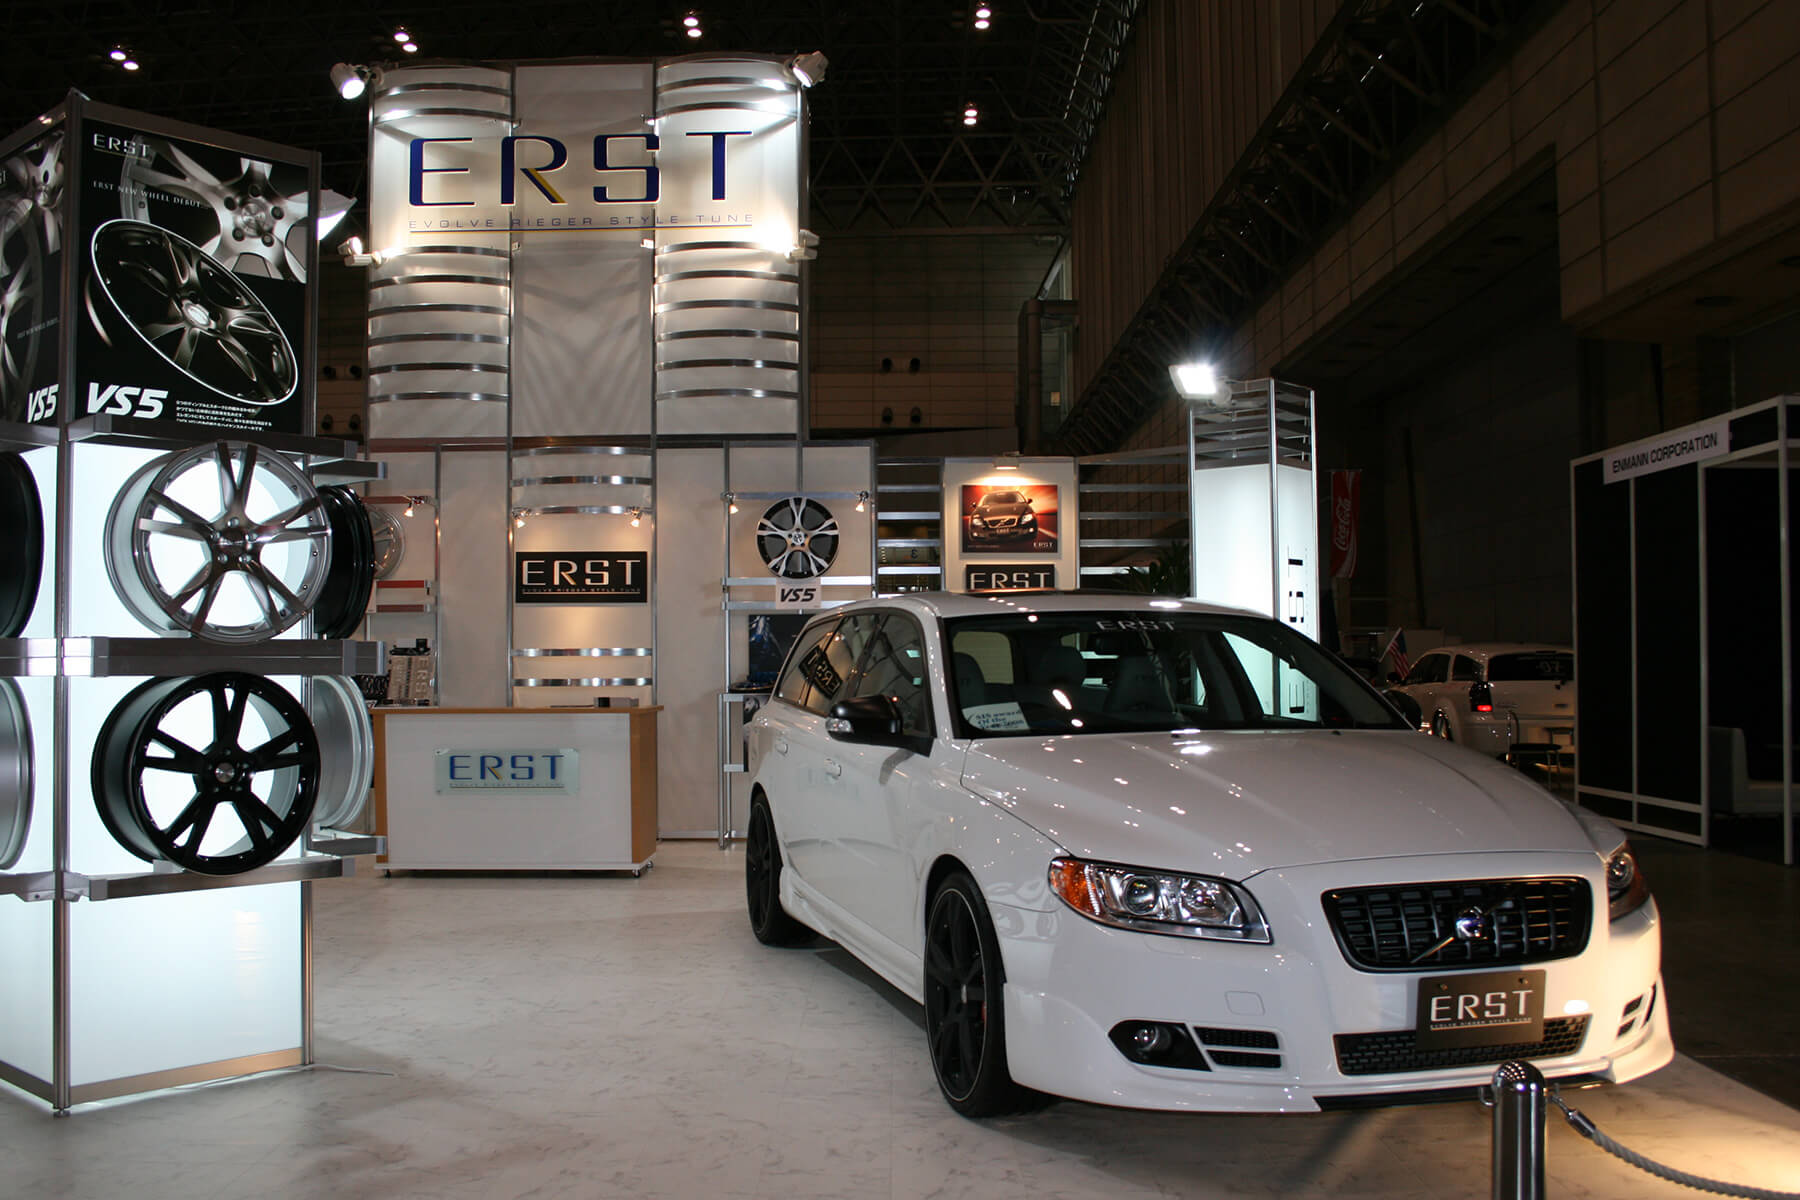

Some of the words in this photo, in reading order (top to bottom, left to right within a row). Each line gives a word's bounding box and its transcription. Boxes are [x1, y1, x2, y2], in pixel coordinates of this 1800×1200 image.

[93, 133, 151, 157] ERST
[409, 131, 753, 206] ERST
[140, 188, 170, 202] WHEEL
[409, 218, 495, 229] EVOLVE
[511, 217, 592, 227] RIEGER
[610, 215, 679, 225] STYLE
[695, 214, 753, 224] TUNE
[26, 384, 59, 423] VS5
[87, 382, 169, 419] VS5
[1612, 452, 1650, 473] ENMANN
[1650, 432, 1718, 463] CORPORATION
[522, 559, 641, 586] ERST
[970, 572, 1051, 590] ERST
[779, 588, 817, 602] VS5
[1096, 620, 1175, 631] ERST
[1287, 544, 1305, 714] EST
[449, 754, 565, 780] ERST
[1430, 989, 1534, 1022] ERST
